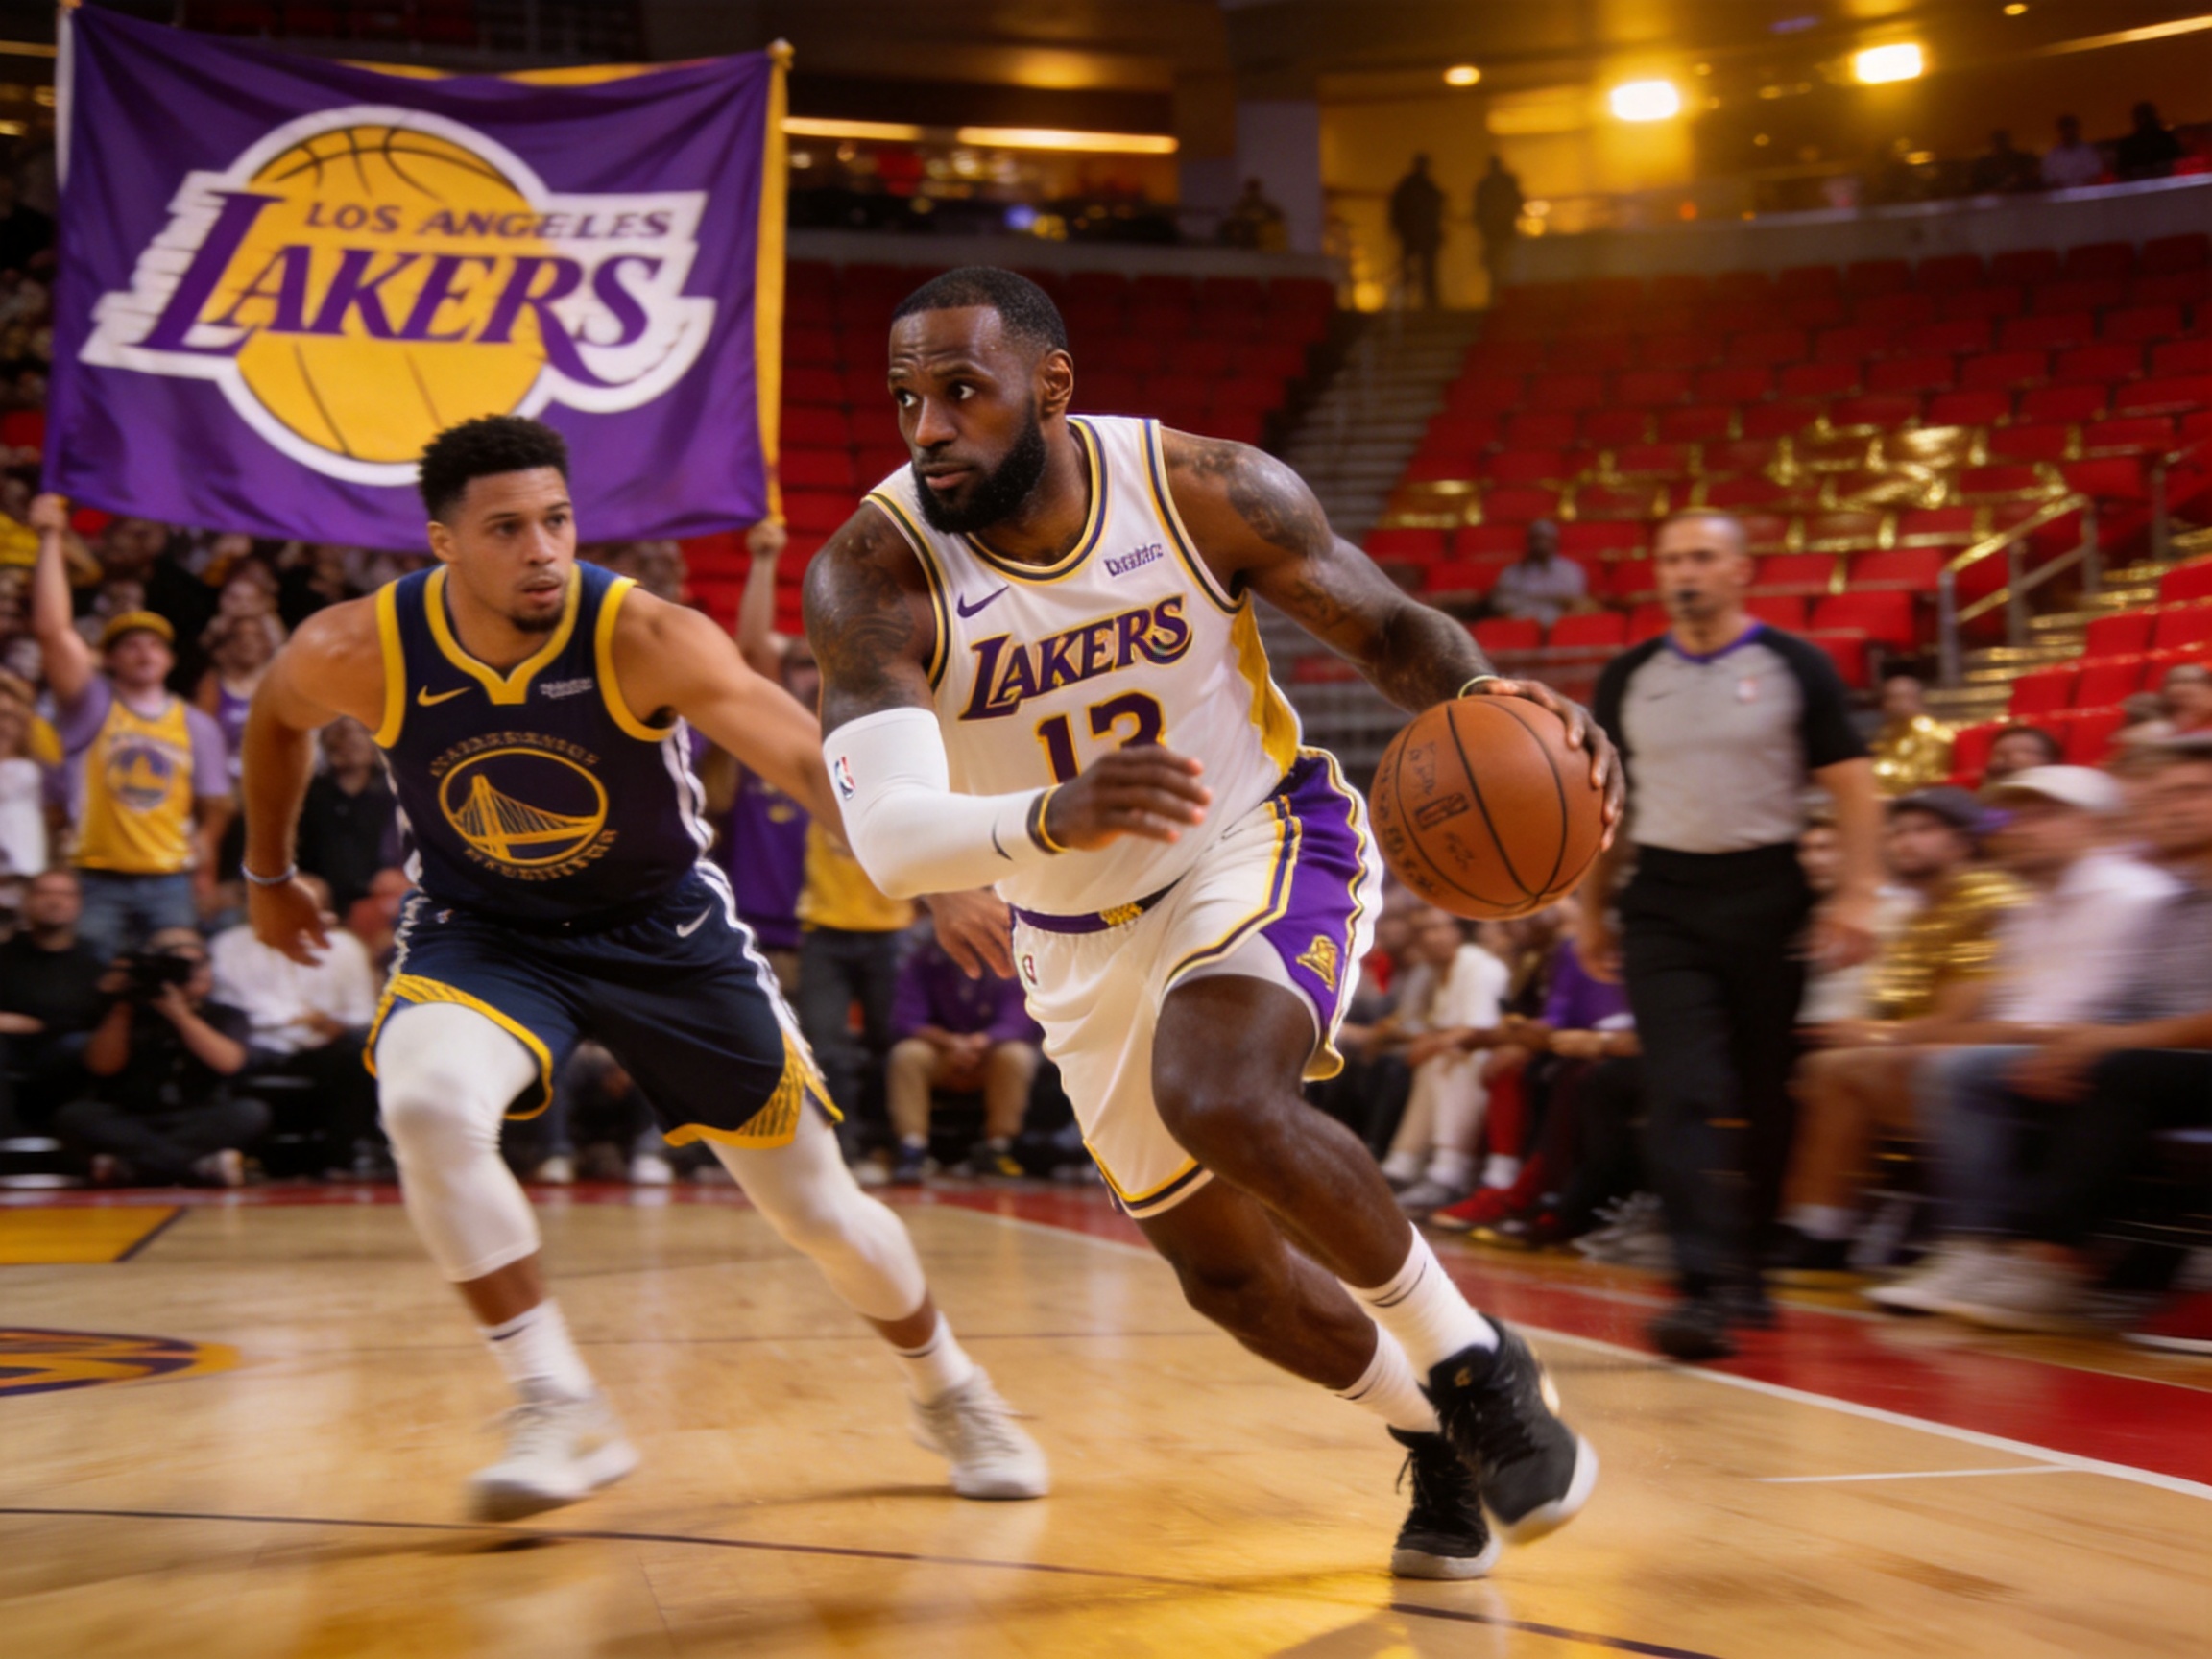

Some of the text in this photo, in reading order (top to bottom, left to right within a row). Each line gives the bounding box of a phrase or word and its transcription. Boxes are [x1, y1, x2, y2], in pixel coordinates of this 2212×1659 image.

[304, 203, 672, 240] LOS ANGELES
[136, 191, 664, 386] LAKERS
[958, 593, 1192, 721] LAKERS
